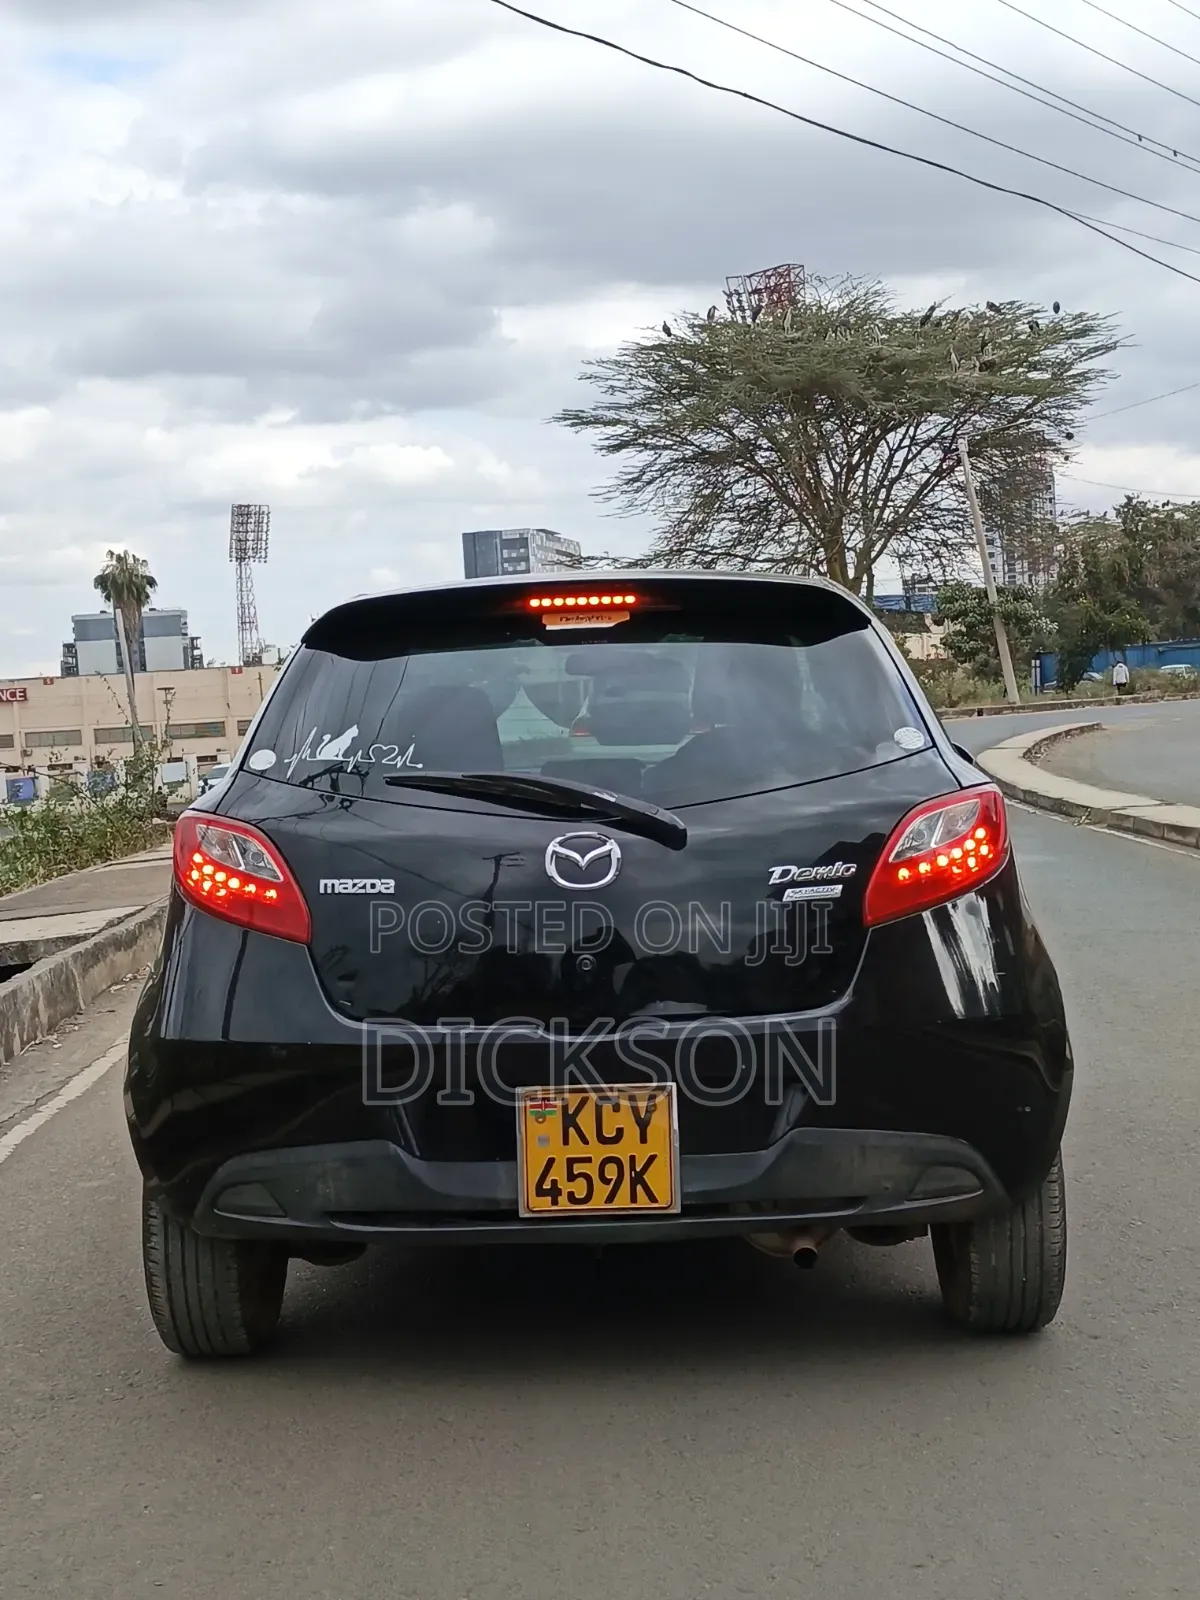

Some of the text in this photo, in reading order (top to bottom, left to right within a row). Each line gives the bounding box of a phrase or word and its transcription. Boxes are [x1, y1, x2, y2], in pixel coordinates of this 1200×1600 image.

[768, 861, 857, 885] Demio
[561, 1094, 657, 1146] KCY
[535, 1154, 659, 1206] 459K
